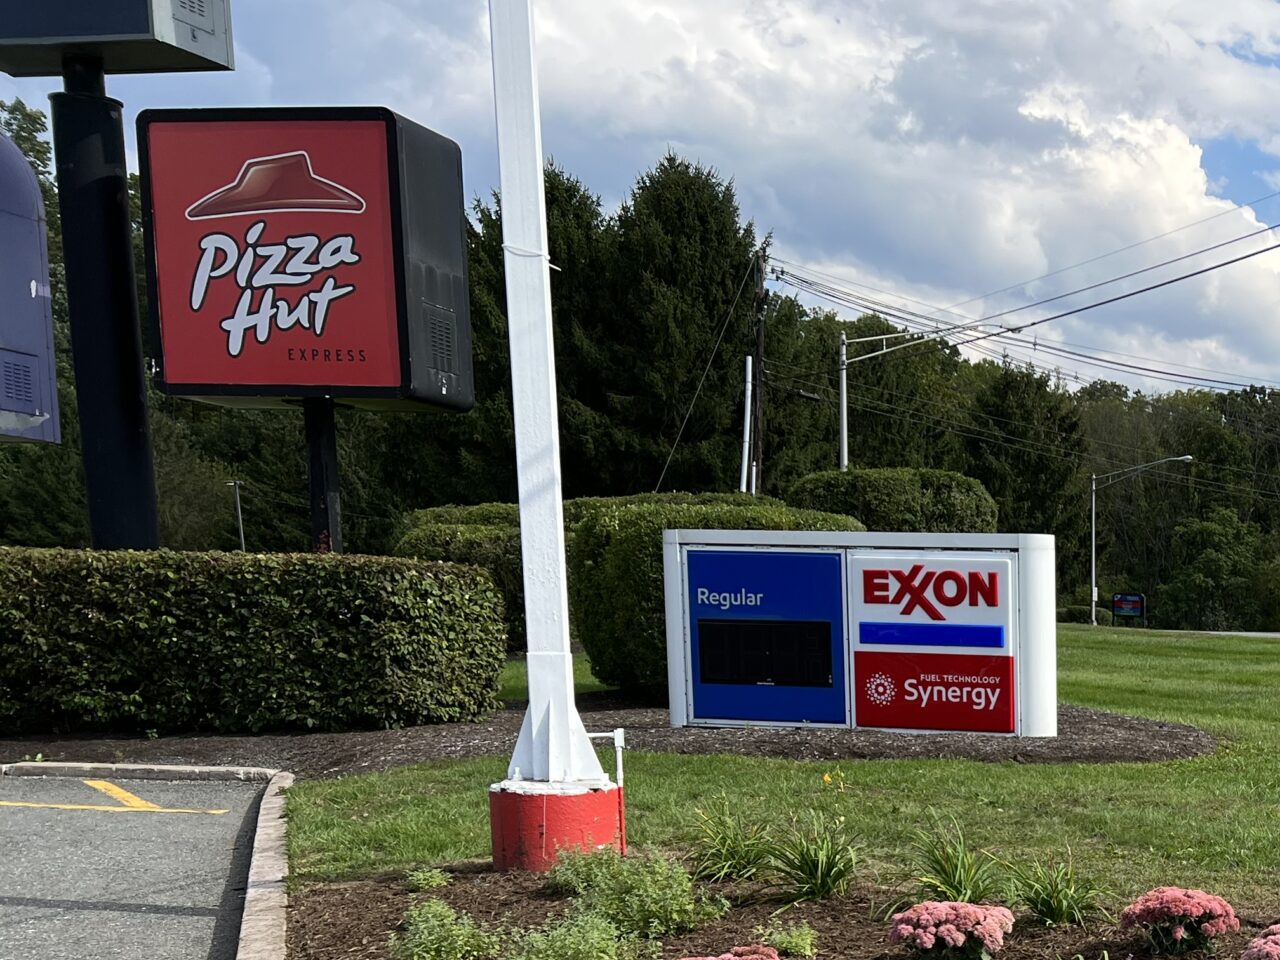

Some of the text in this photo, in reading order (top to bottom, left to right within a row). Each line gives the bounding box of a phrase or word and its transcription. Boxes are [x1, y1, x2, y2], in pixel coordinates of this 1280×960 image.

[190, 220, 360, 312] Pizza
[220, 276, 356, 357] Hut
[287, 347, 368, 363] EXPRESS
[697, 587, 764, 610] Regular
[863, 563, 999, 621] EXXON
[919, 673, 1001, 684] FUEL TECHNOLOGY
[904, 679, 1001, 710] Synergy
